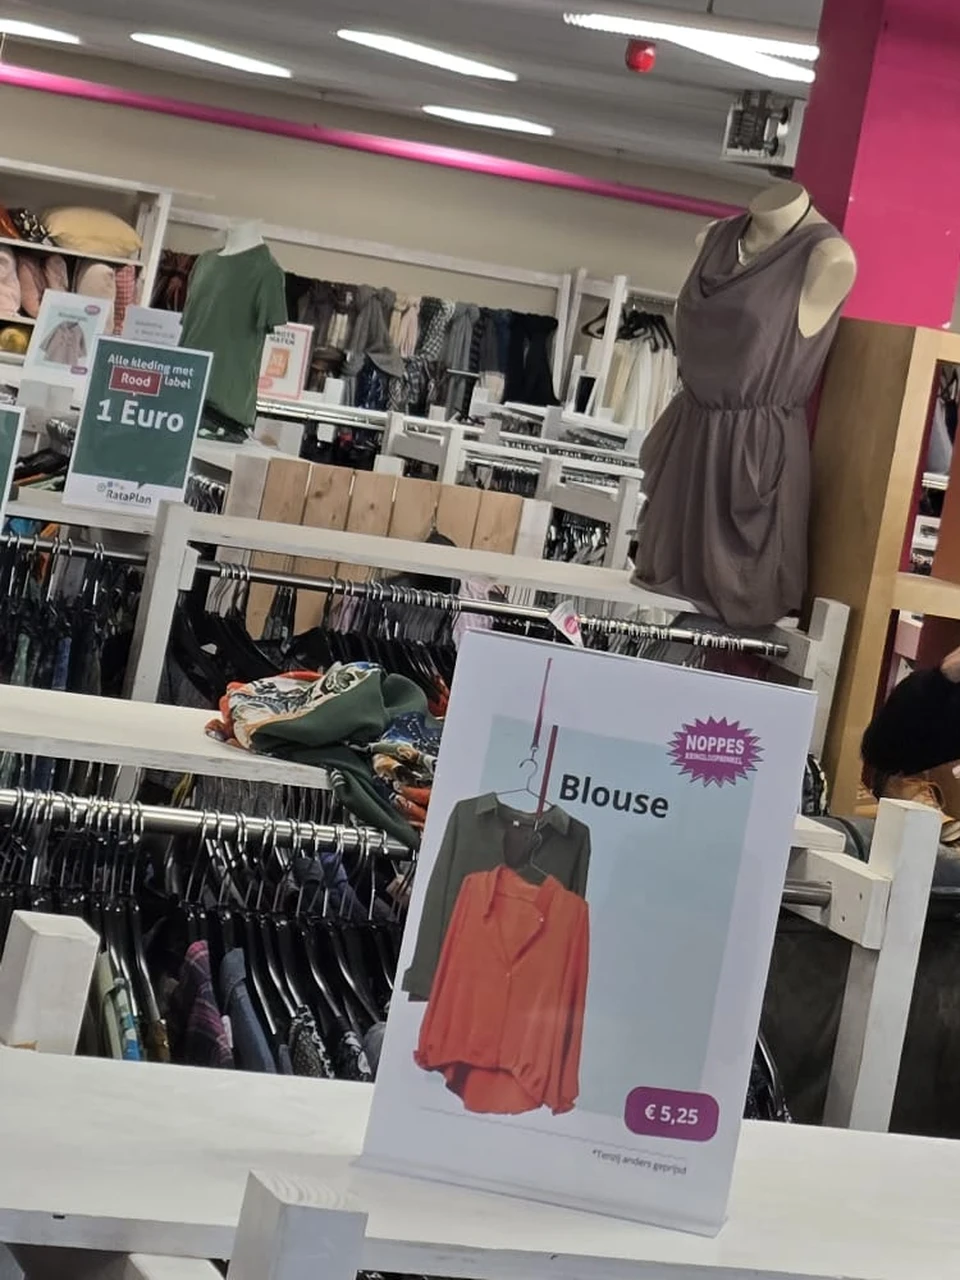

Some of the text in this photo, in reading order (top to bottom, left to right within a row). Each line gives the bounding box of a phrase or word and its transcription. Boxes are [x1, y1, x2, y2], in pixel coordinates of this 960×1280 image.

[107, 354, 194, 377] Alle kleding met
[121, 372, 192, 389] Rood label
[96, 399, 184, 433] 1 Euro
[106, 488, 152, 505] RataPlan
[686, 734, 745, 755] NOPPES
[558, 773, 671, 819] Blouse
[644, 1103, 699, 1125] € 5,25
